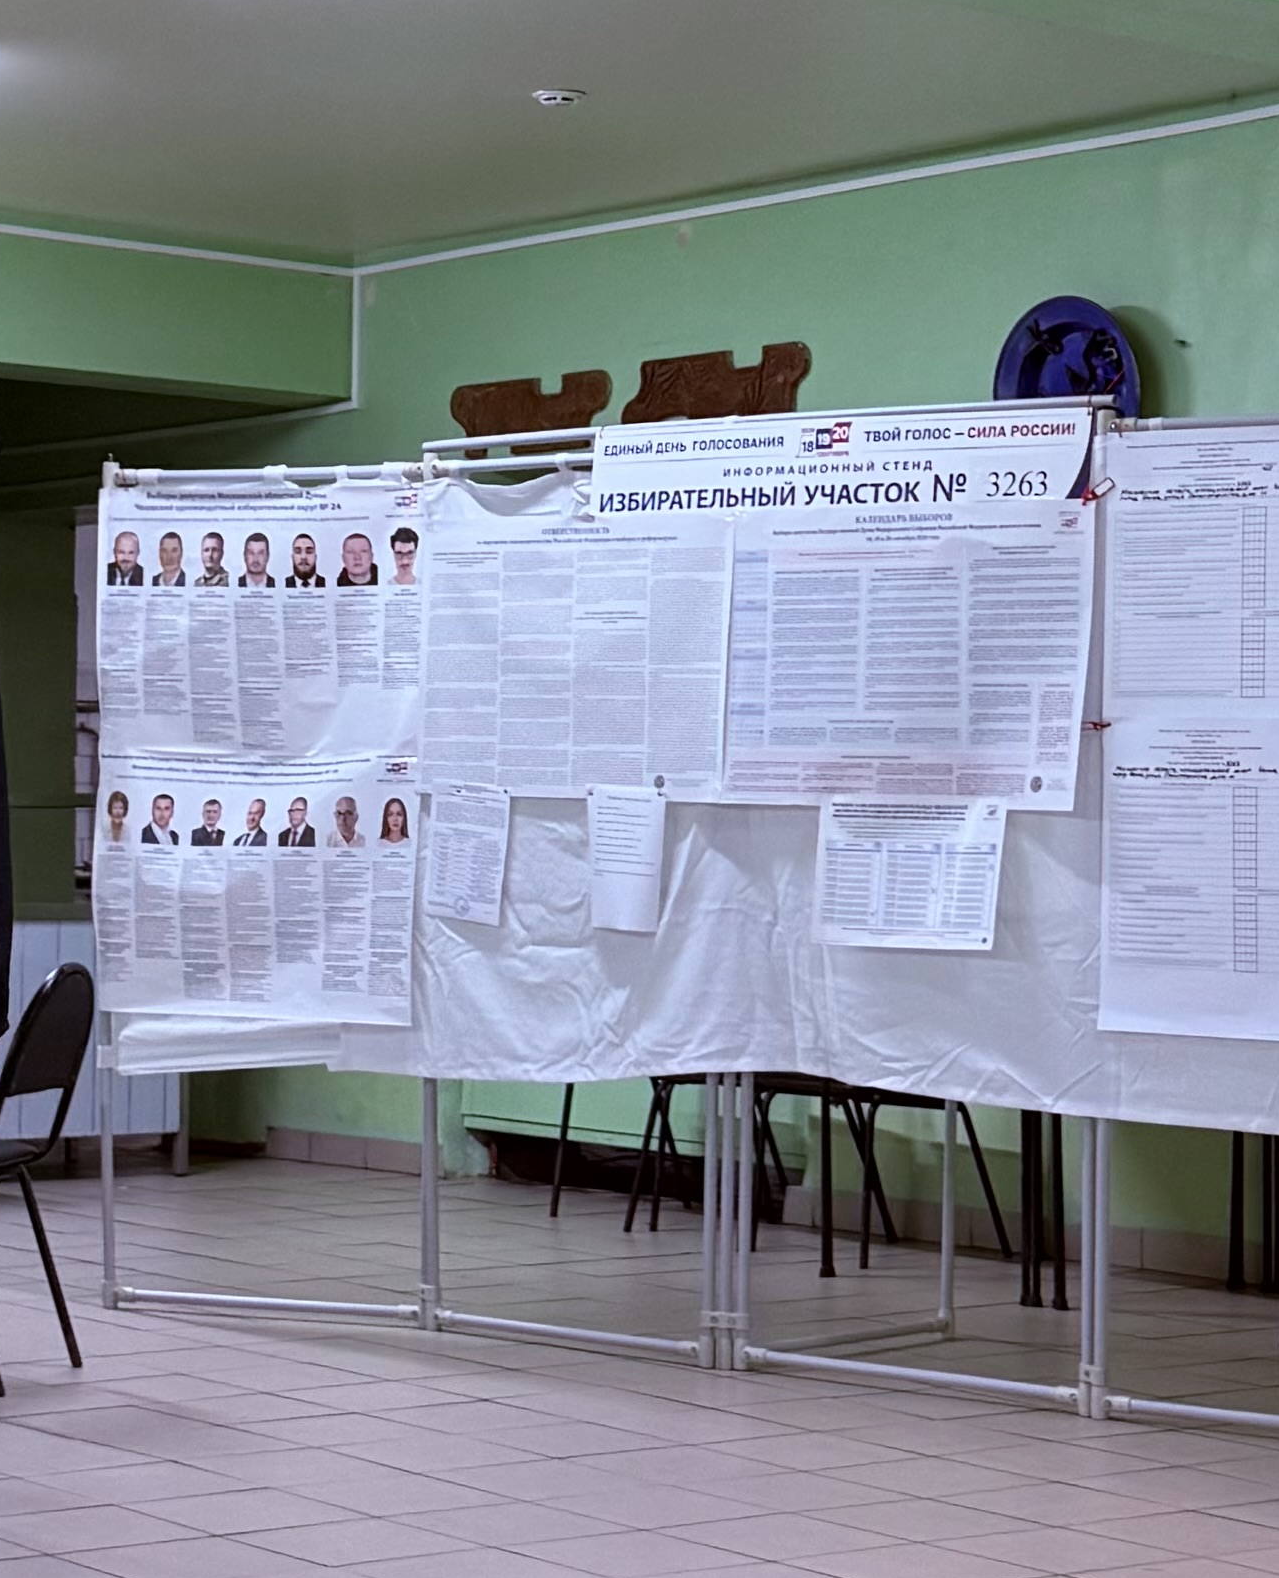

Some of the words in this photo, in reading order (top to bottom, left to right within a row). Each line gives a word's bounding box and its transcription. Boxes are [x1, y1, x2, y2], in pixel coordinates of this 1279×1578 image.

[832, 425, 849, 440] 20
[864, 426, 901, 443] ТВОЙ
[905, 427, 951, 441] ГОЛОС
[967, 425, 1007, 439] СИЛА
[1010, 423, 1076, 437] РОССИИ!
[604, 440, 653, 457] ЕДИНЫЙ
[655, 442, 687, 456] ДЕНЬ
[692, 436, 785, 452] ГОЛОСОВАНИЯ
[801, 440, 814, 453] 18
[722, 460, 875, 478] ИНФОРМАЦИОННЫЙ
[882, 459, 933, 472] СТЕНД
[599, 481, 796, 513] ИЗБИРАТЕЛЬНЫЙ
[804, 481, 920, 507] УЧАСТОК
[932, 473, 967, 503] №
[985, 470, 1048, 498] 3263
